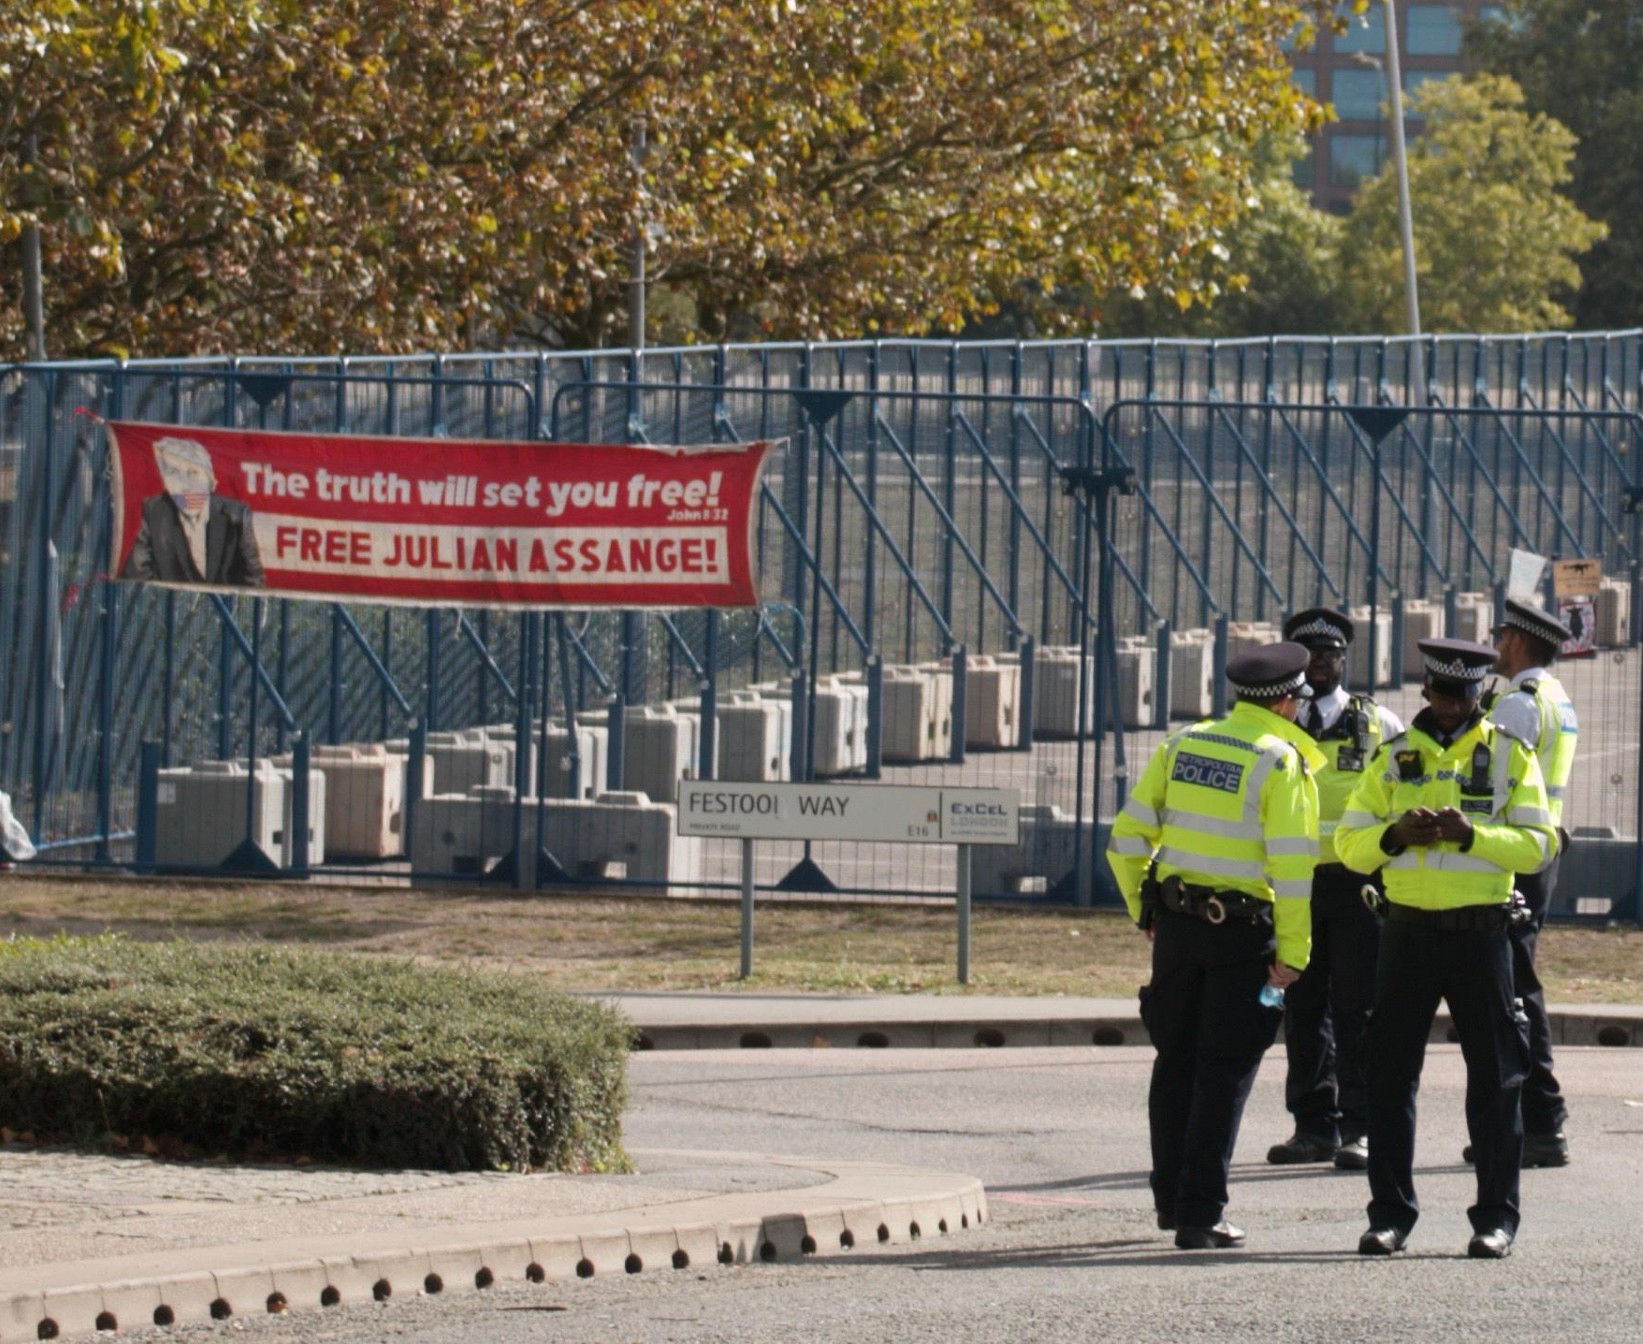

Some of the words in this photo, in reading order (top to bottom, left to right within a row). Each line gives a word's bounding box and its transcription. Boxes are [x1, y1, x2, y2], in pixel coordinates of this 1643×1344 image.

[241, 462, 309, 498] The
[316, 468, 411, 505] truth
[418, 474, 478, 507] will
[483, 476, 541, 507] set
[546, 481, 618, 517] you
[627, 471, 723, 507] free!
[667, 509, 701, 522] John
[276, 526, 372, 565] FREE
[383, 534, 518, 573] JULIAN
[528, 538, 718, 573] ASSANGE!
[1173, 763, 1240, 791] POLICE
[799, 796, 850, 817] WAY
[907, 825, 929, 837] E16
[950, 815, 1008, 828] LONDON
